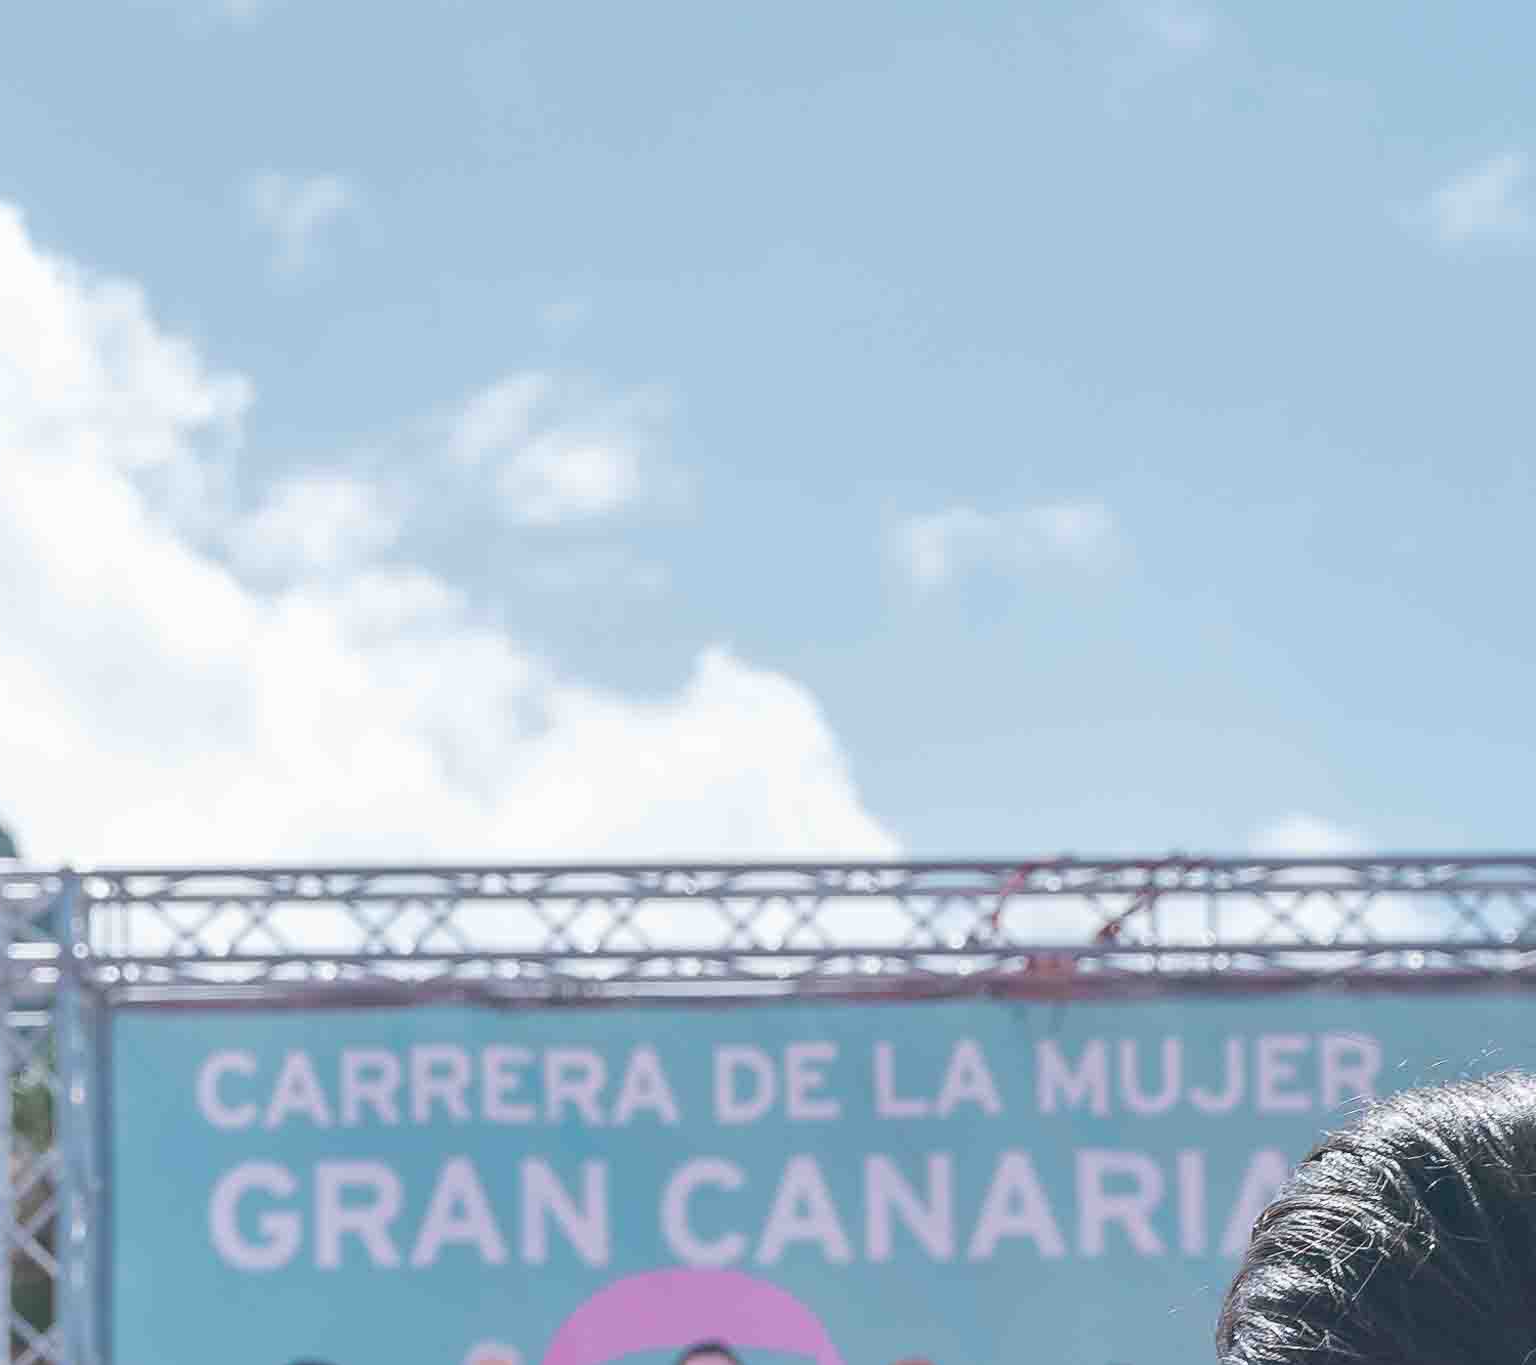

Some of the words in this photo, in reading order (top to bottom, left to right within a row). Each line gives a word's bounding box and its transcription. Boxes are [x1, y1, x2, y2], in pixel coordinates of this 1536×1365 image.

[195, 1043, 679, 1130] CARRERA
[713, 1041, 840, 1125] DE
[871, 1037, 1001, 1119] LA
[1035, 1031, 1383, 1118] MUJER
[209, 1156, 614, 1269] GRAN
